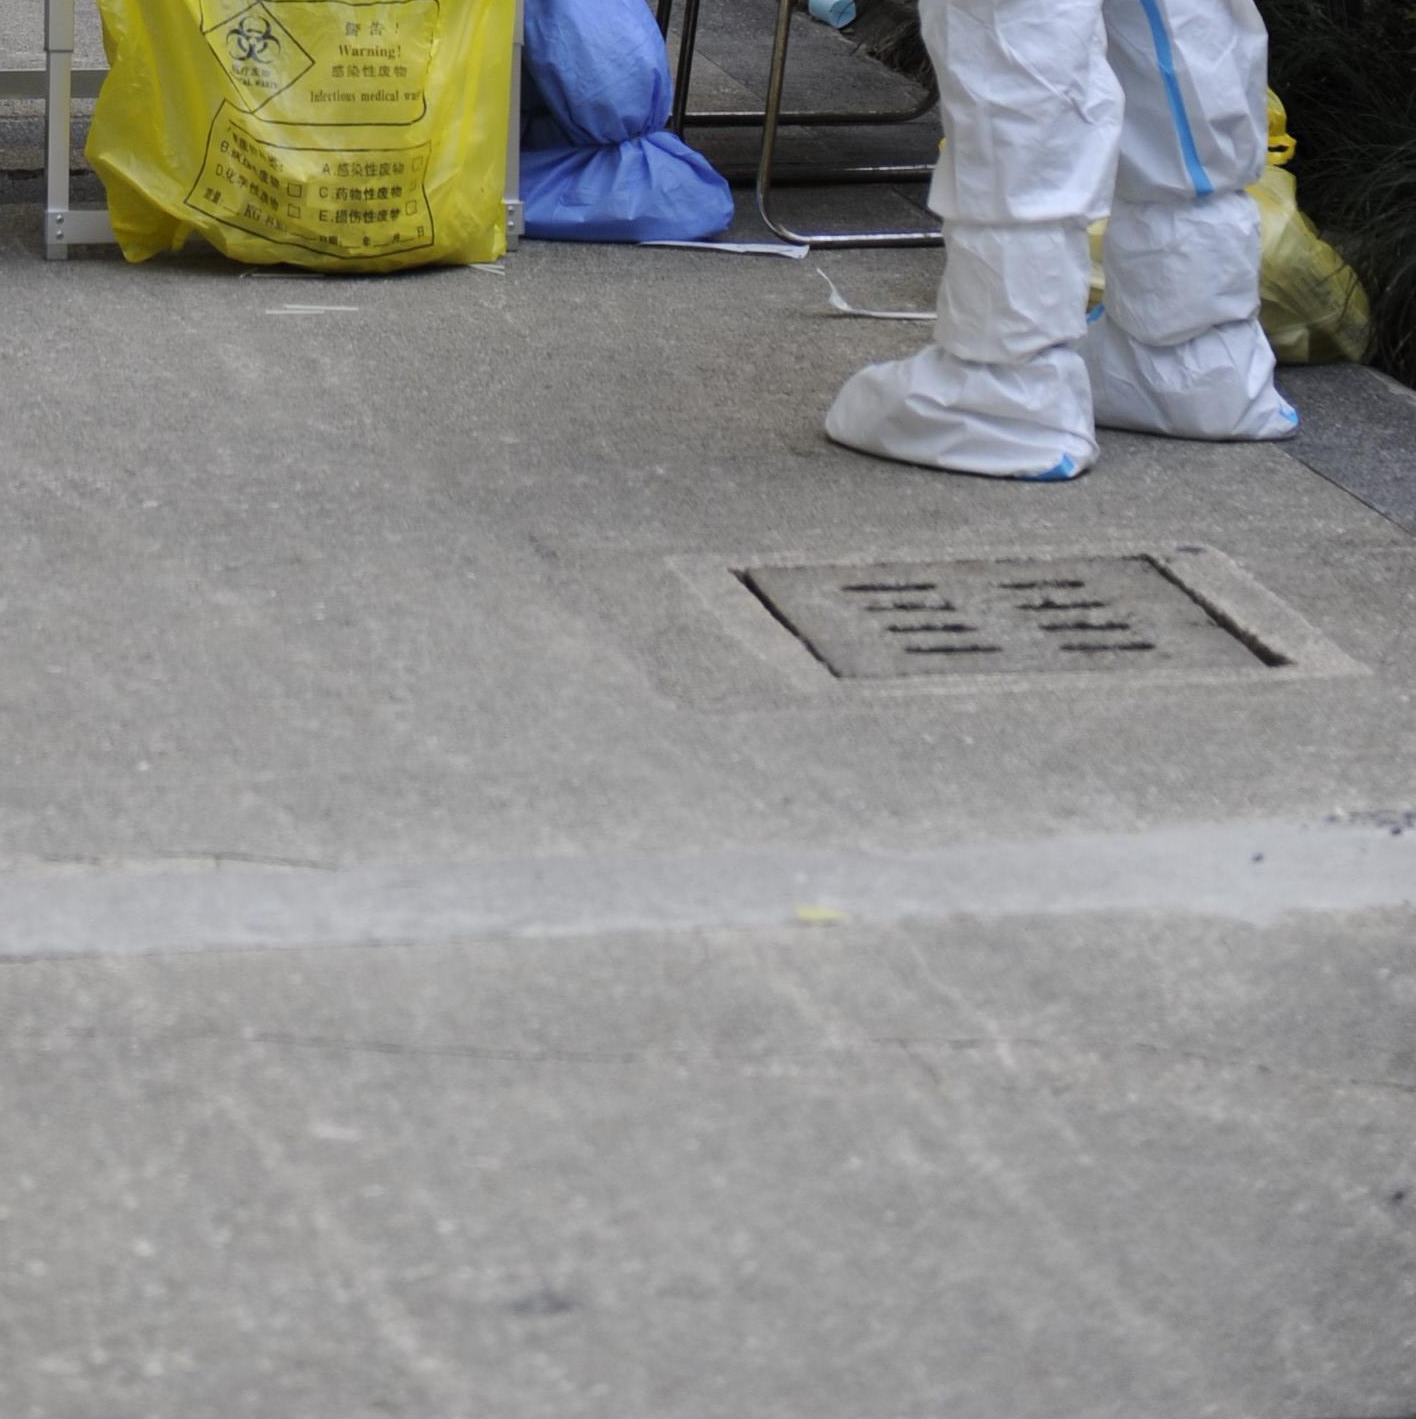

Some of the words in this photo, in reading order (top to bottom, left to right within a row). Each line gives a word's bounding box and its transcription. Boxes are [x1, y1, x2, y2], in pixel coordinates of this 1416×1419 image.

[339, 44, 402, 60] Warning!
[331, 64, 408, 78] 感染性废物
[309, 90, 356, 103] Infectious
[361, 89, 400, 102] medical
